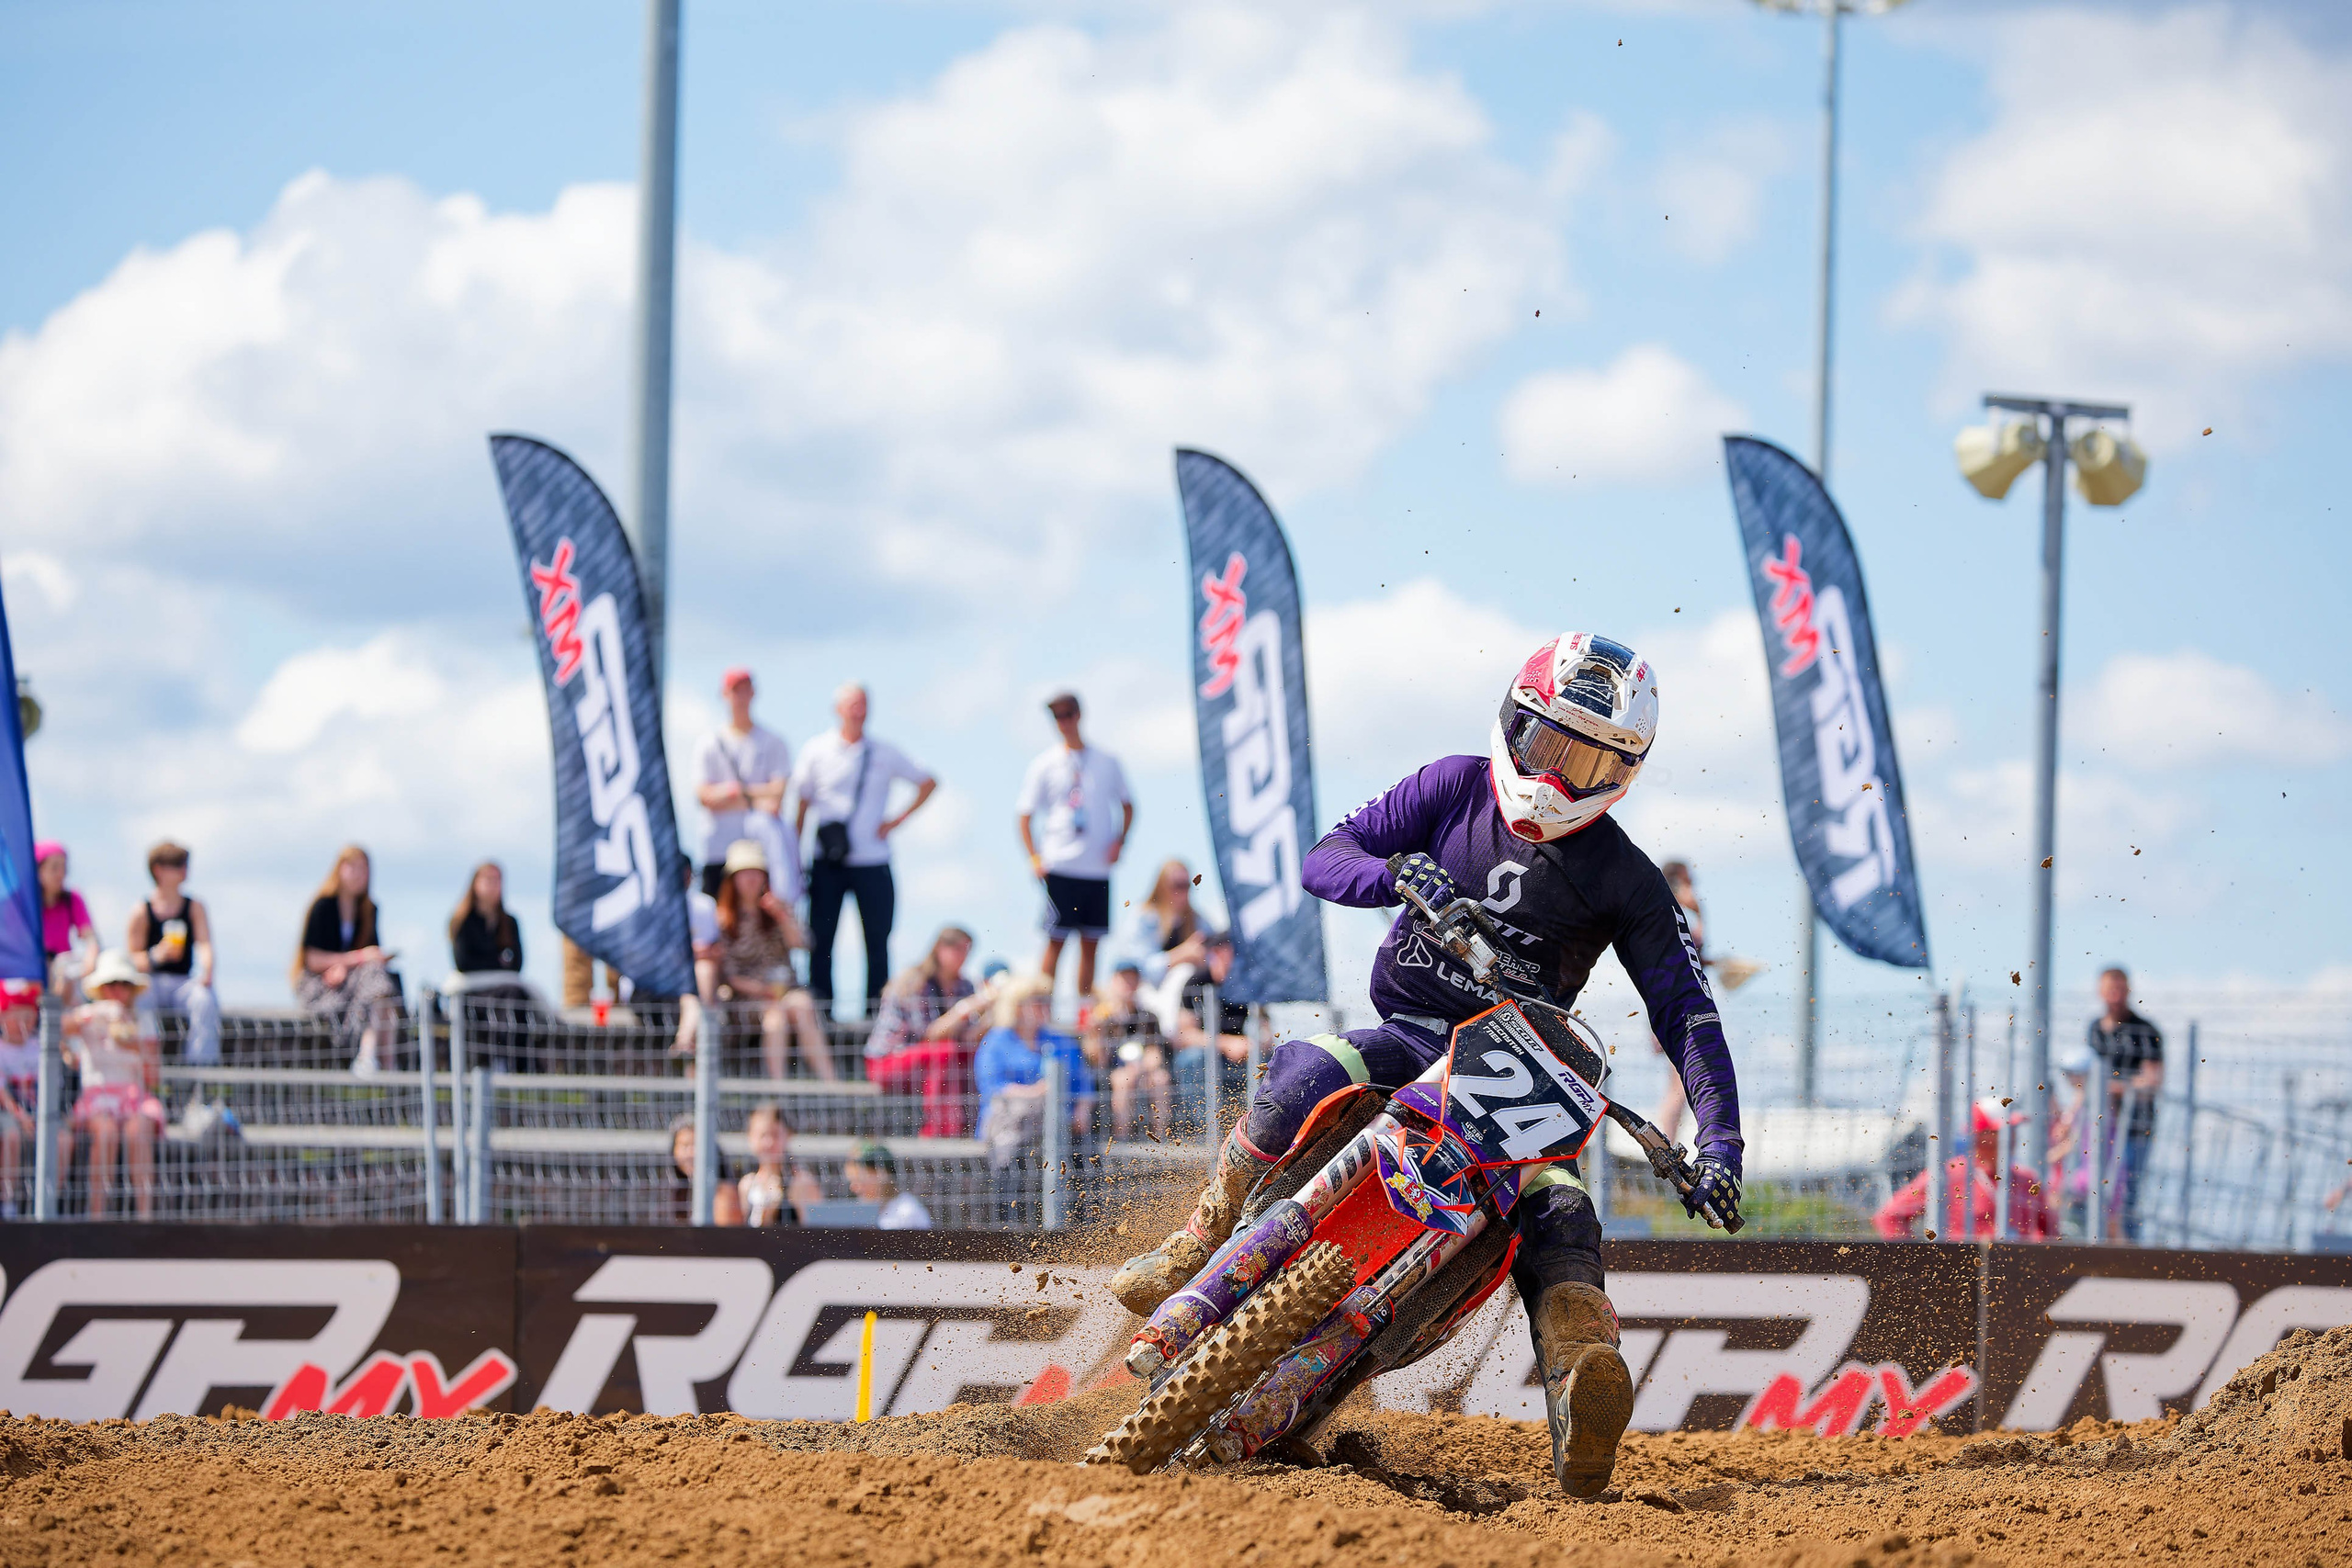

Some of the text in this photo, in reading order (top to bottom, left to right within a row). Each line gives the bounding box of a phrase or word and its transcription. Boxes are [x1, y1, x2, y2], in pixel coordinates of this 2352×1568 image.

[1483, 1025, 1503, 1044] ГЛЕБ
[1487, 1020, 1525, 1056] БЕСПУТИН
[1510, 1020, 1544, 1053] SCOTT
[1448, 1050, 1581, 1161] 24
[1557, 1070, 1595, 1104] RGP
[0, 1258, 401, 1420] GP
[534, 1255, 1128, 1420] RGP
[1738, 1360, 1977, 1438] MX
